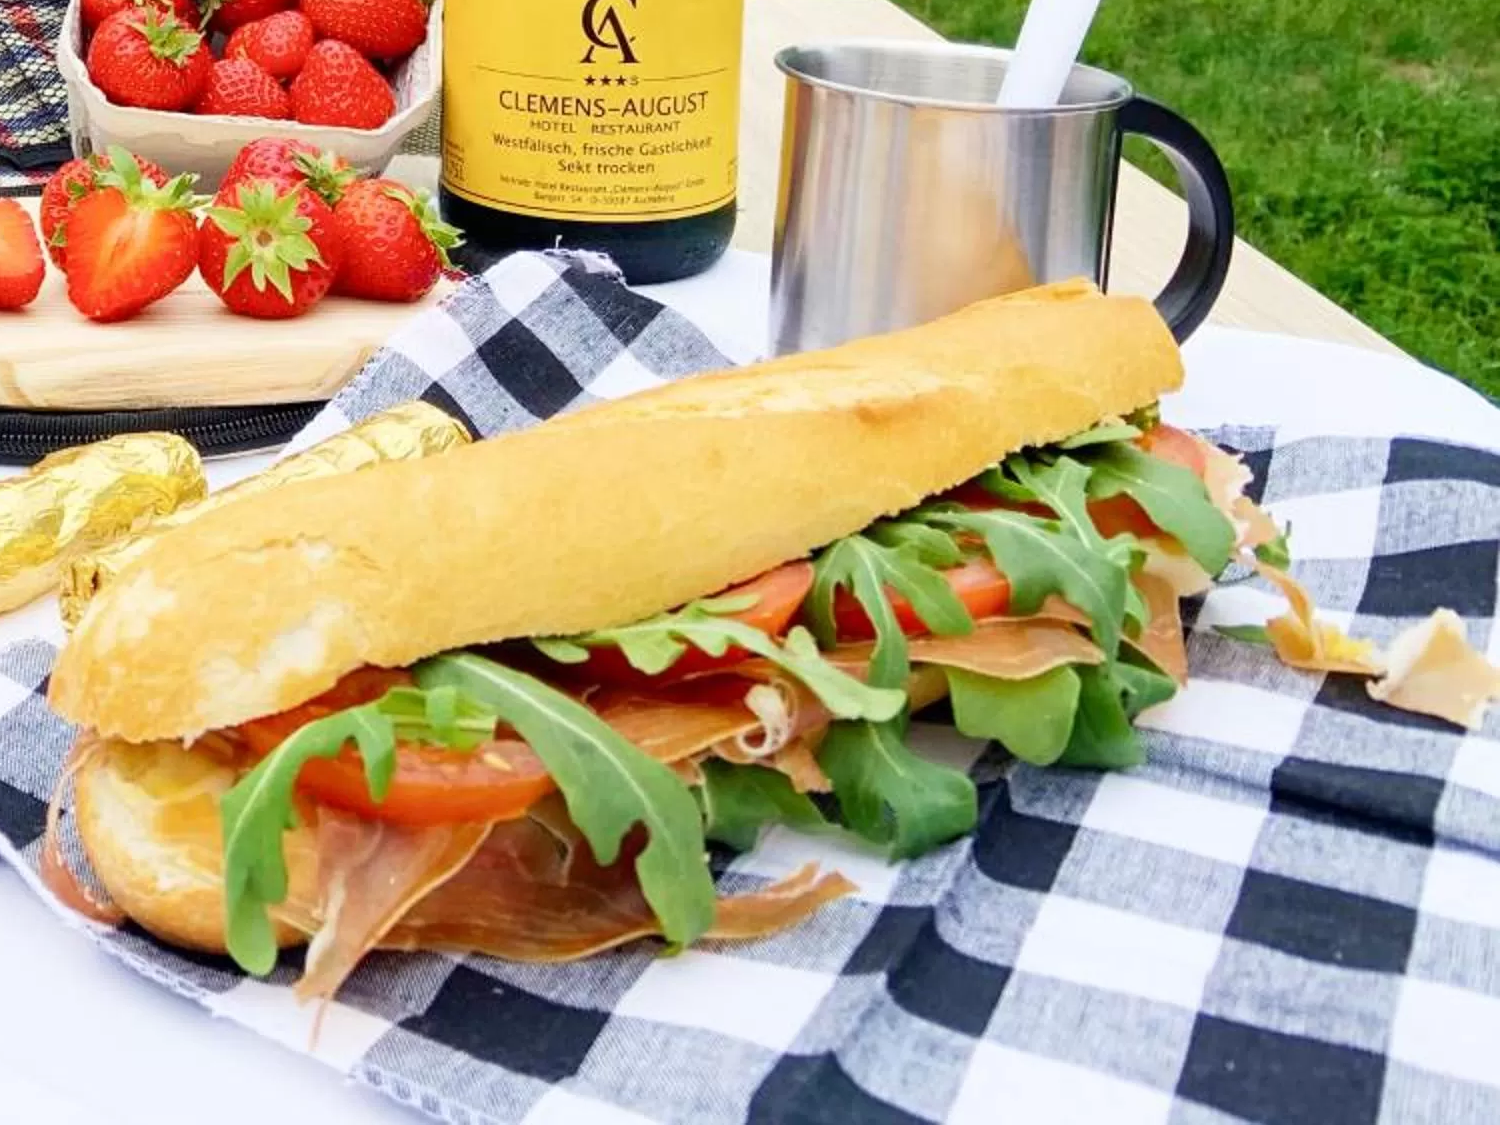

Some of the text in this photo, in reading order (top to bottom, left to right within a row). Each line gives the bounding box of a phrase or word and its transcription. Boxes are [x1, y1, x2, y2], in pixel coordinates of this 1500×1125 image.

[500, 90, 709, 118] CLEMENS-AUGUST
[530, 120, 681, 135] HOTEL RESTAURANT
[582, 143, 635, 156] frische
[639, 137, 712, 156] Gastlichkeit
[557, 159, 654, 174] Sekt trocken
